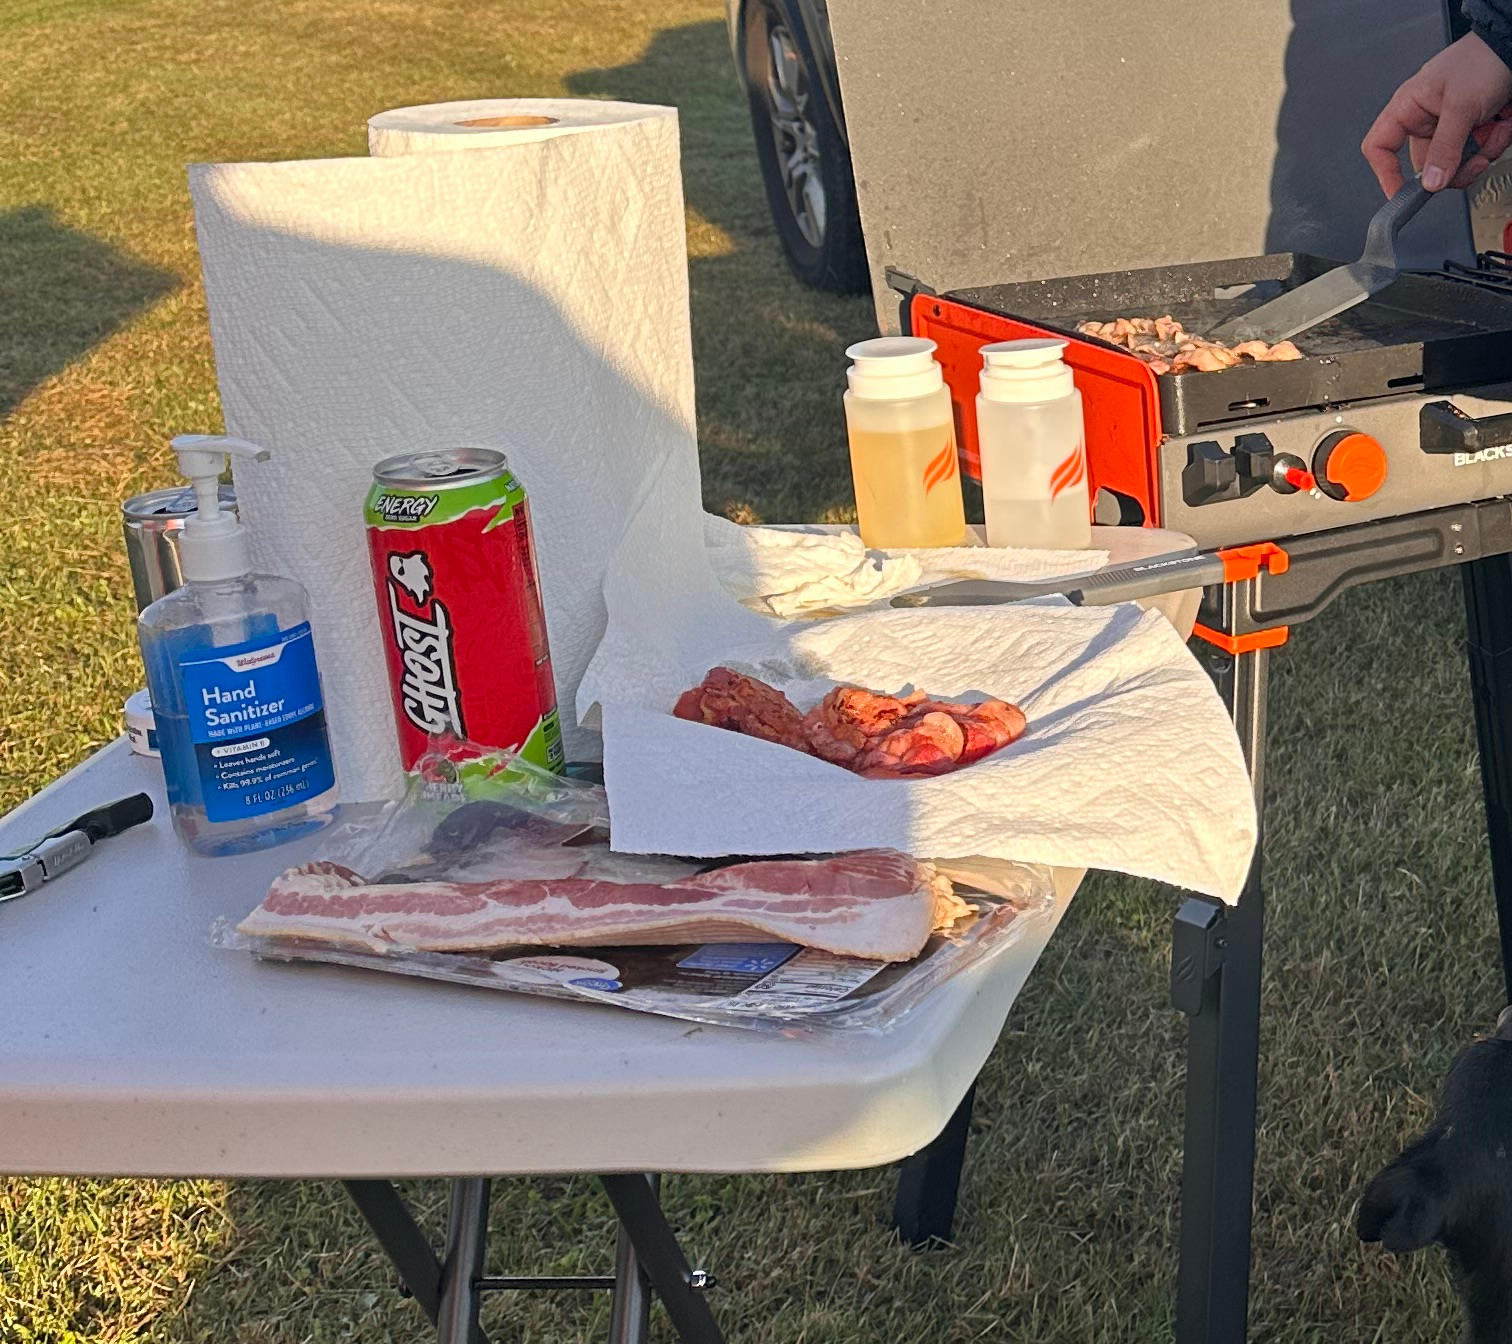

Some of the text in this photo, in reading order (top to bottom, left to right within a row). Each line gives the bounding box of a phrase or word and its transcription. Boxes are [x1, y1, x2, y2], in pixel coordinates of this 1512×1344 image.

[374, 495, 439, 517] ENERGY
[1133, 555, 1207, 572] BLACKSTONE
[388, 580, 463, 739] GHOST
[201, 679, 256, 706] Hand
[204, 698, 285, 727] Sanitizer
[223, 741, 259, 754] VITAMIN
[264, 789, 276, 801] OZ
